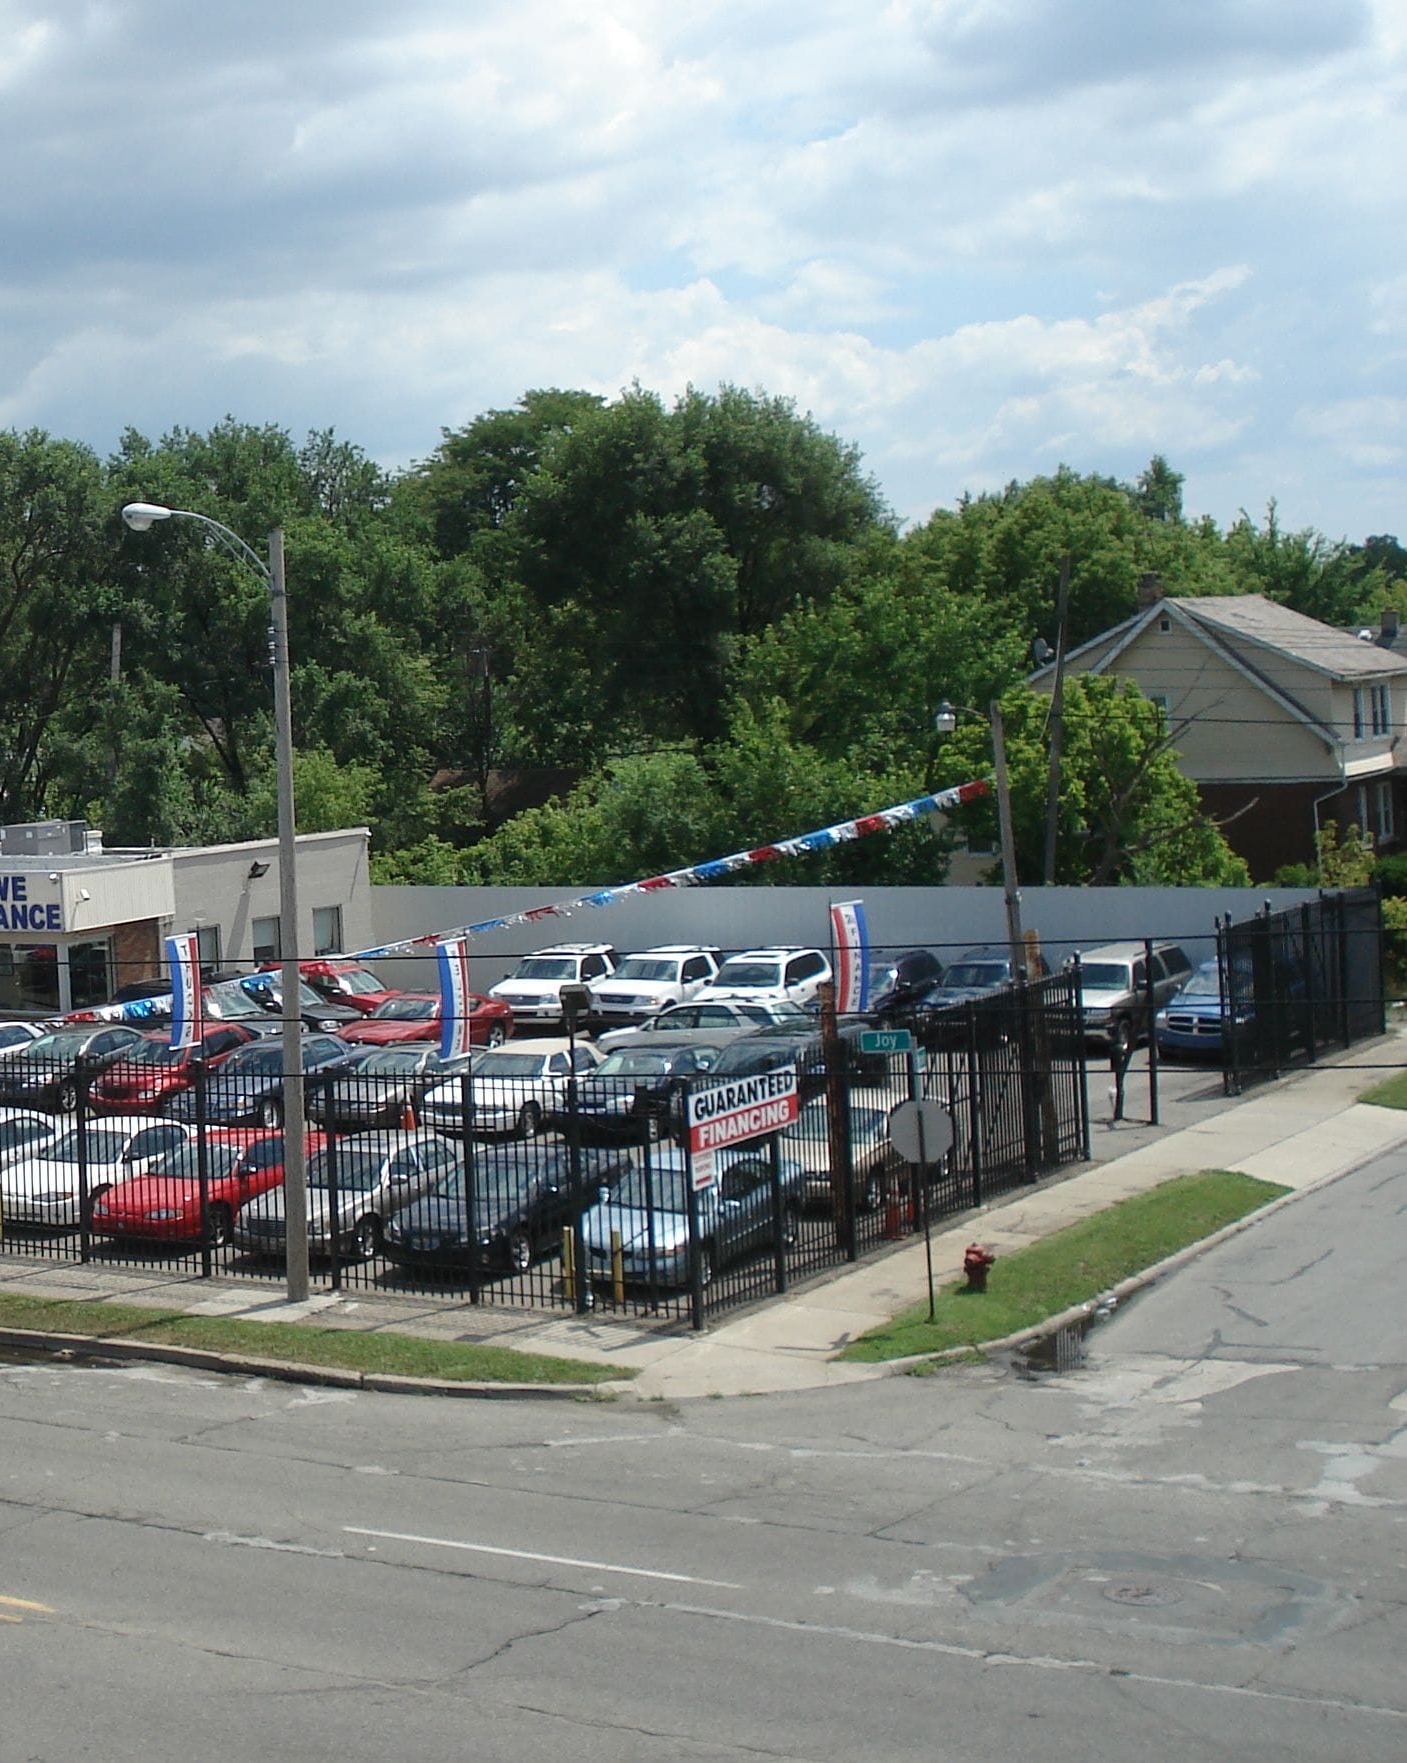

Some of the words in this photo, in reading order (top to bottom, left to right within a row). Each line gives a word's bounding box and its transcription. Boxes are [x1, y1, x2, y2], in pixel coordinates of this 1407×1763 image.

[874, 1033, 897, 1050] Joy
[694, 1070, 793, 1121] GUARANTEED
[698, 1099, 790, 1149] FINANCING
